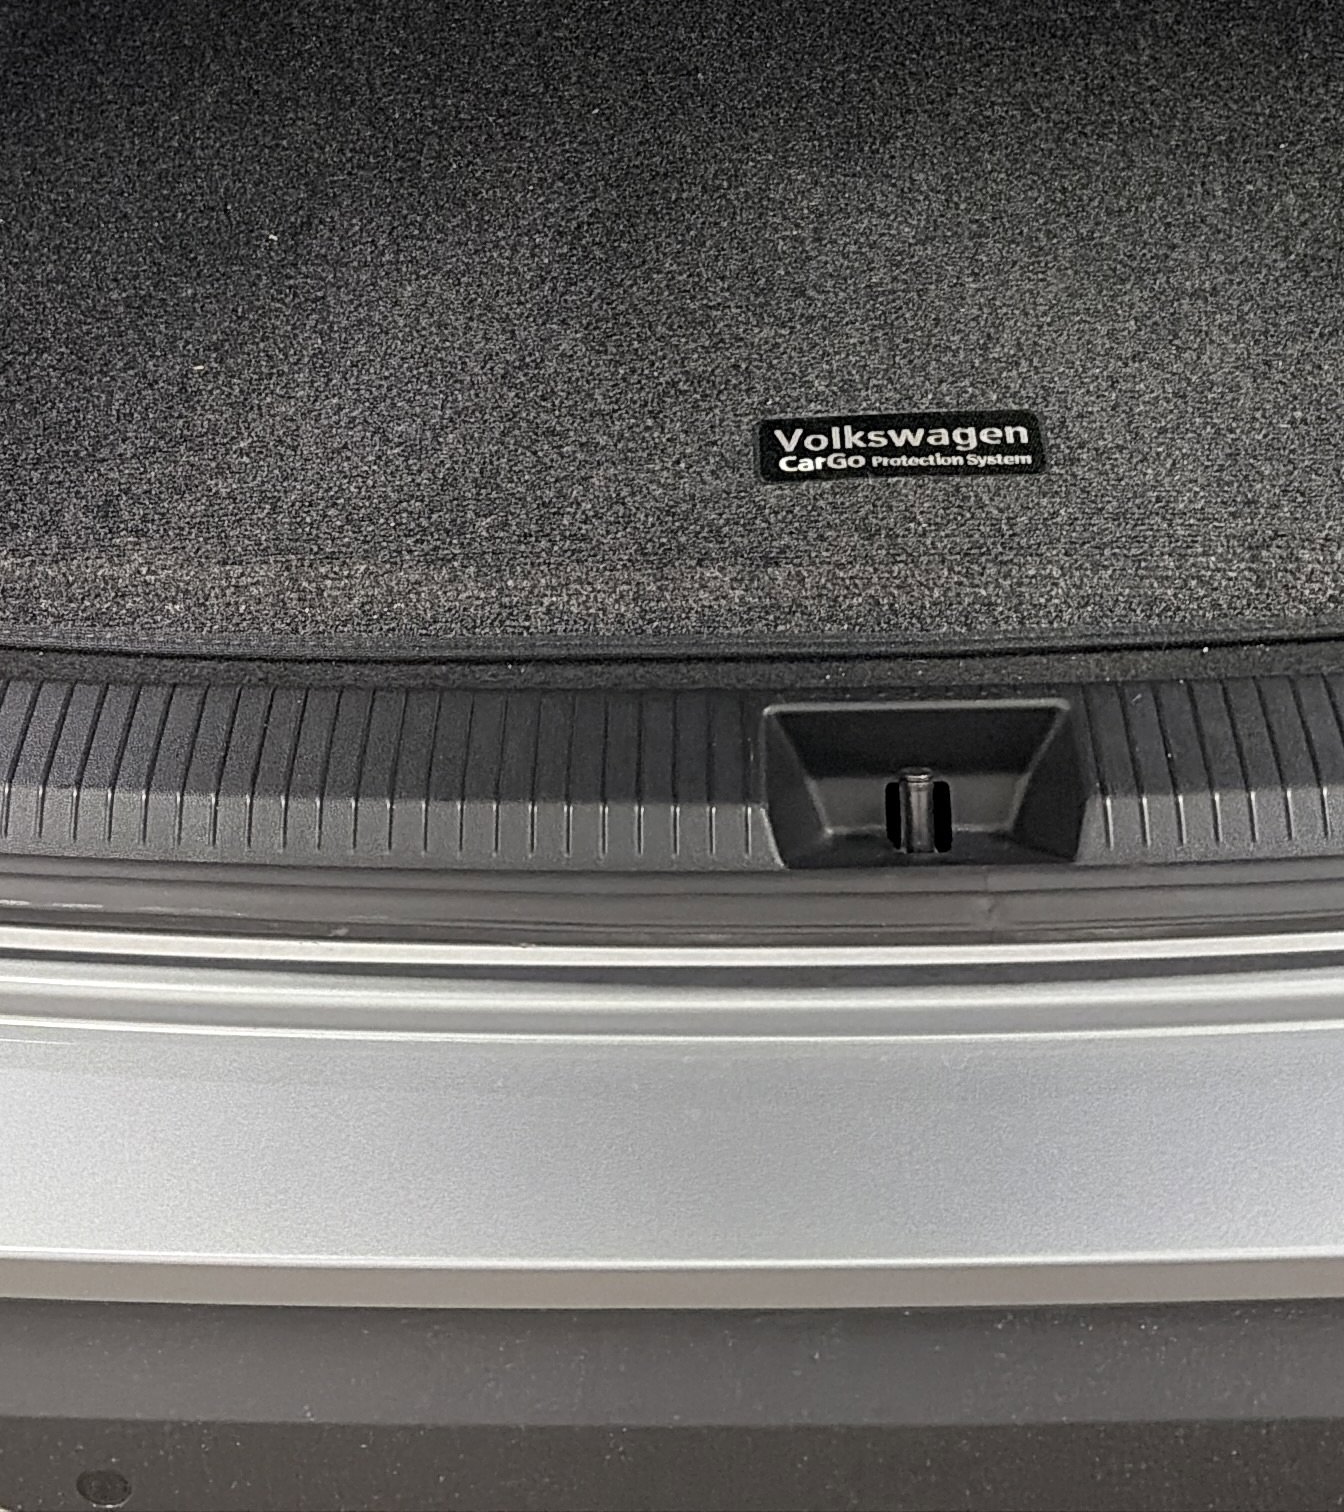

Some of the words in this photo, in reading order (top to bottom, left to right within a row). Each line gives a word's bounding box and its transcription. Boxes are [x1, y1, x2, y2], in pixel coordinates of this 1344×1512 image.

[773, 424, 1029, 453] Volkswagen
[778, 453, 866, 472] CarGo
[871, 453, 965, 467] Protection
[967, 453, 1032, 467] System
